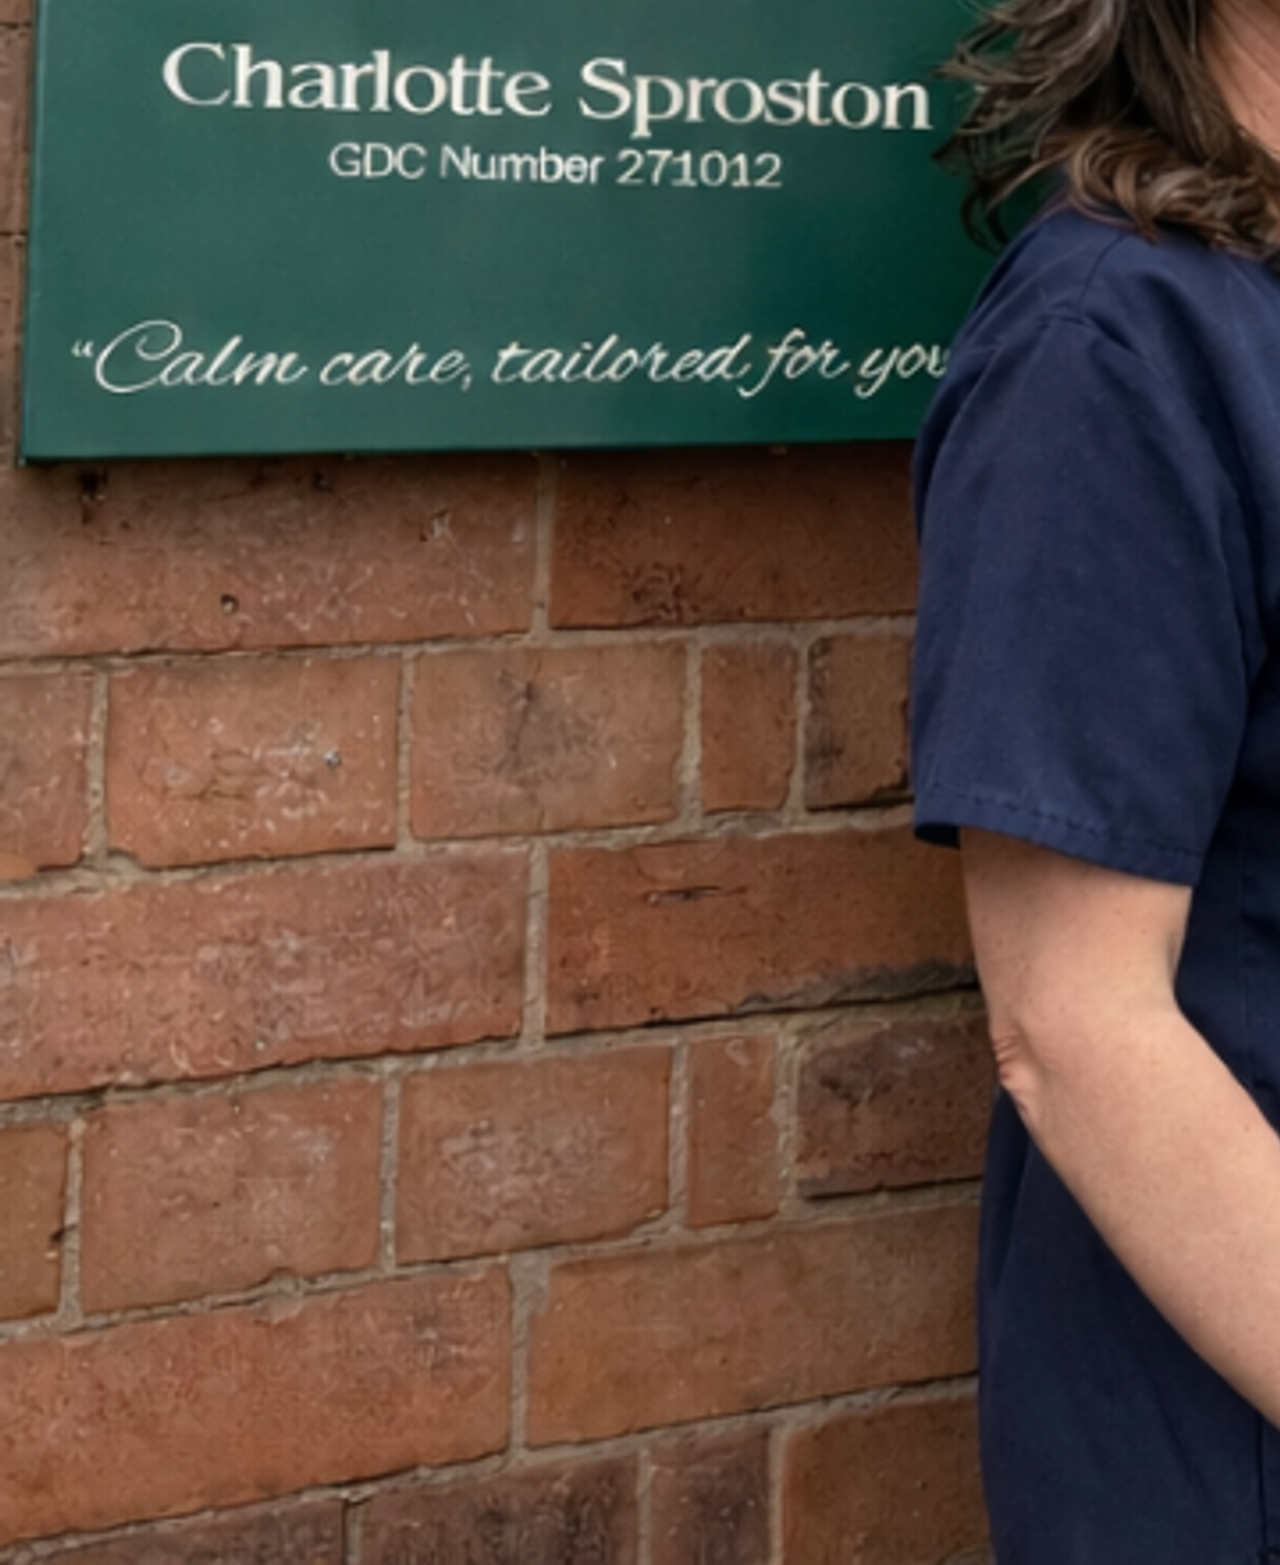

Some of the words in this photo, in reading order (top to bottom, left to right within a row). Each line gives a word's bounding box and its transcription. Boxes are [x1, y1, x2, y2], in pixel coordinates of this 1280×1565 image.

[161, 41, 553, 118] Charlotte
[578, 56, 934, 140] Sproston
[327, 141, 428, 180] GDC
[439, 143, 606, 185] Number
[615, 147, 783, 189] 271012
[318, 341, 474, 392] care,
[490, 332, 752, 384] tailored
[736, 327, 852, 400] for
[853, 342, 951, 400] you
